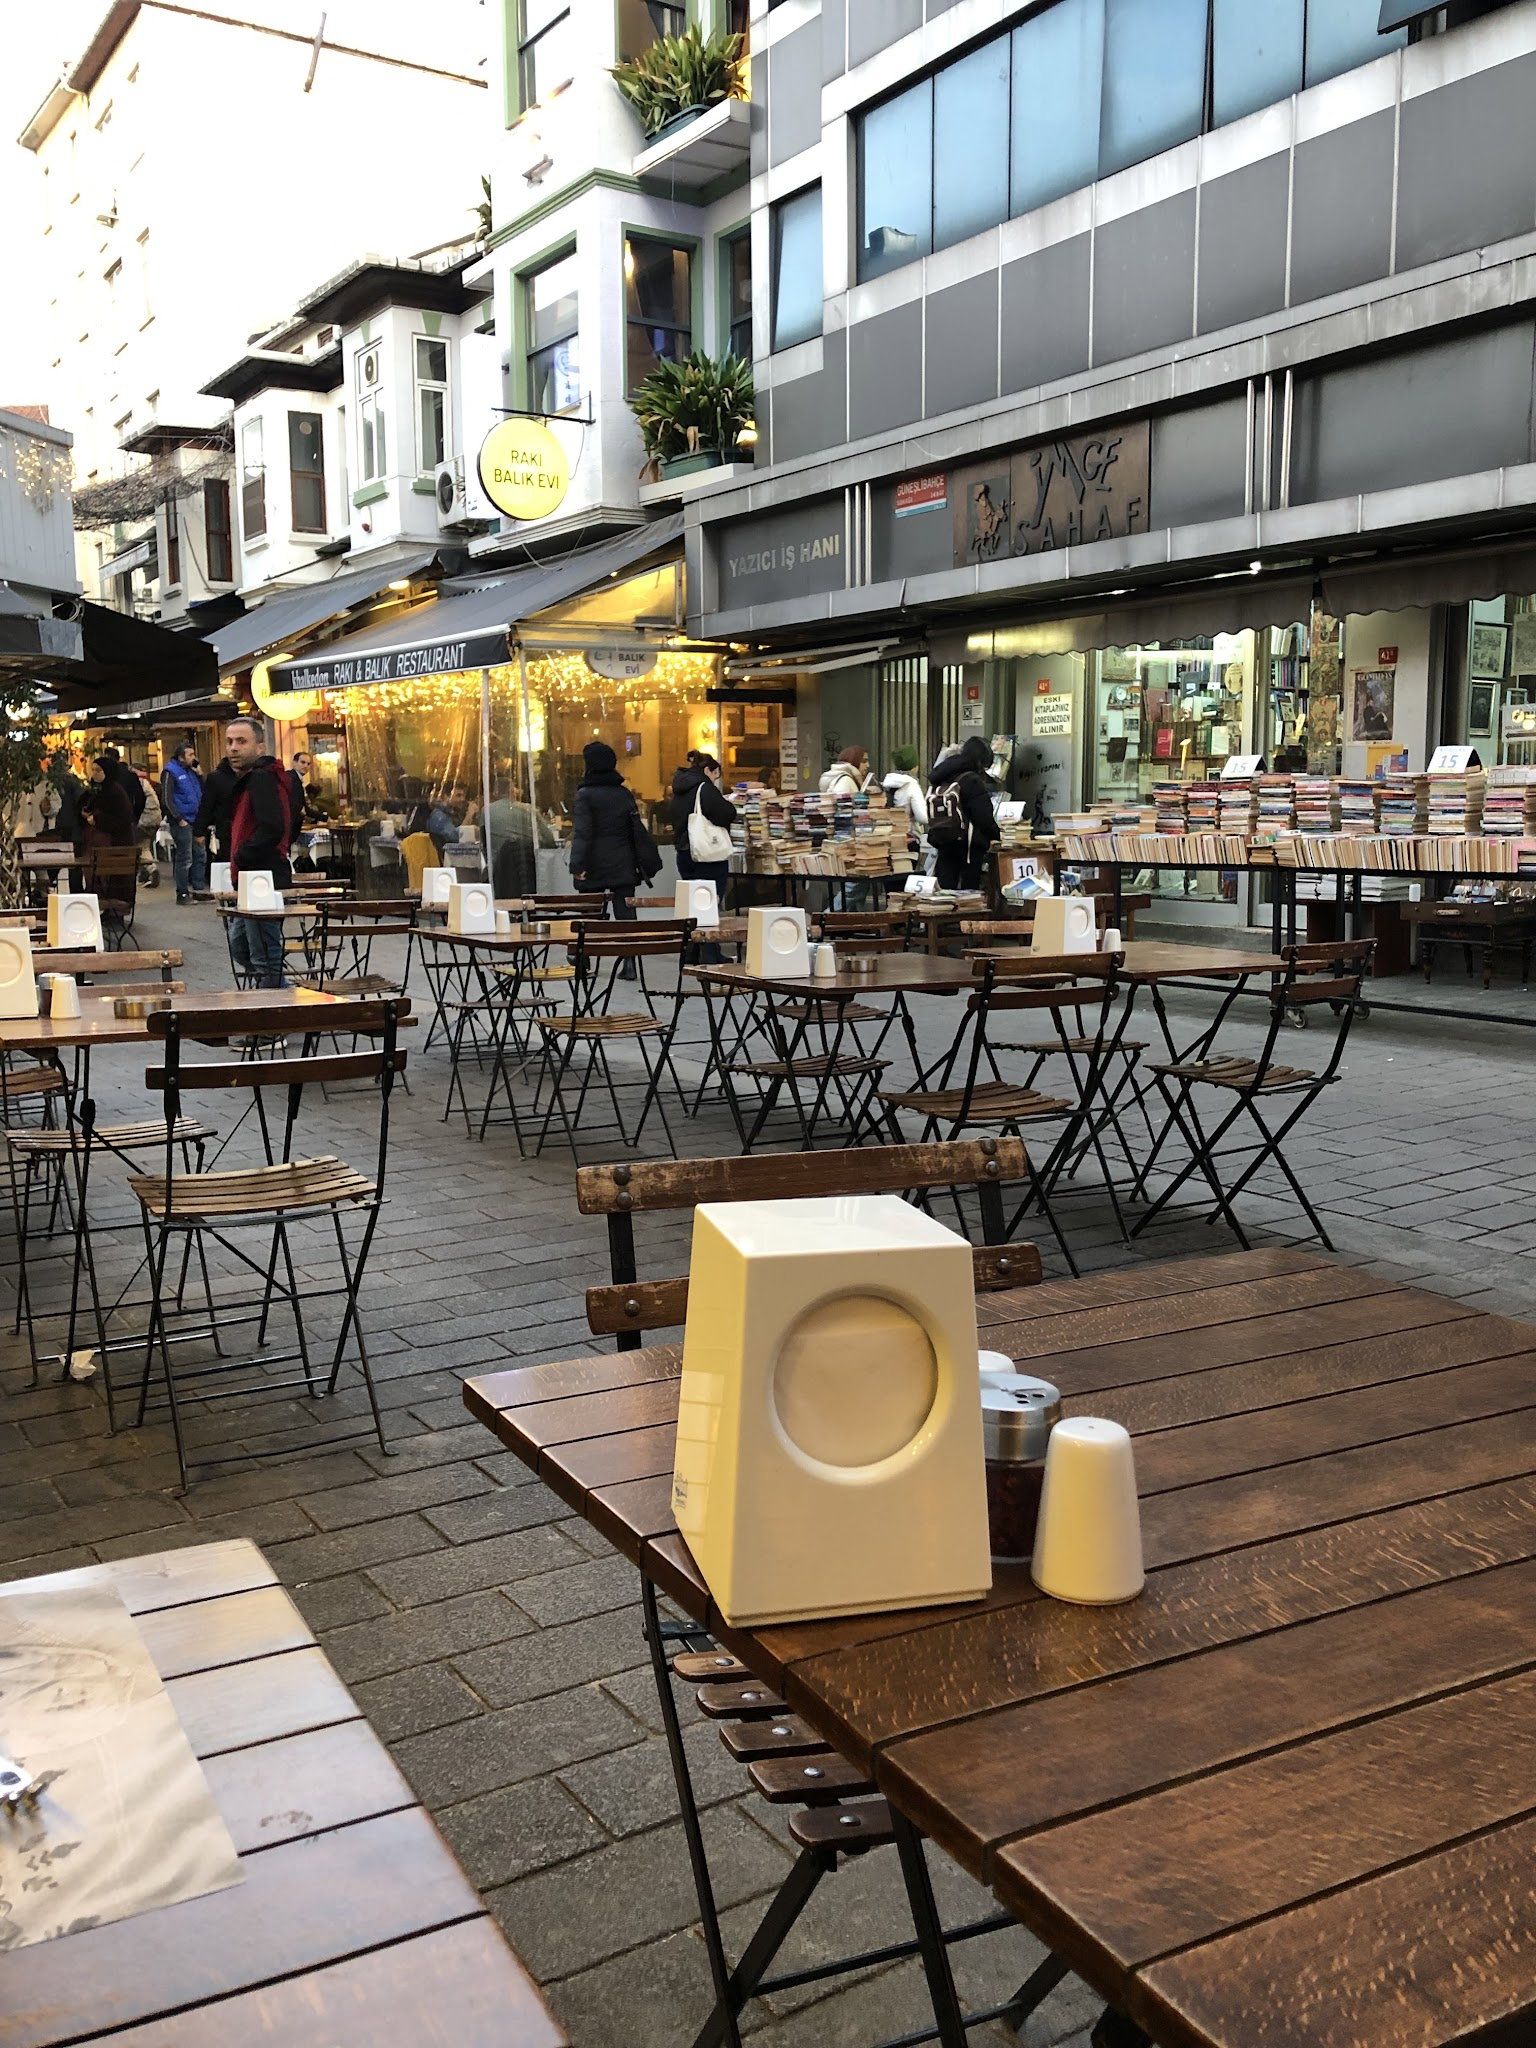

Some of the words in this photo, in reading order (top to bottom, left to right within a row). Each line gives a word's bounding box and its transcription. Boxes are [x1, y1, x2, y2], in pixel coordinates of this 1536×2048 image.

[511, 449, 542, 467] RAKI
[494, 468, 534, 487] BALIK
[538, 473, 559, 489] EVI
[1012, 496, 1141, 557] SAHAF
[729, 549, 776, 578] YAZICI
[781, 543, 795, 571] İŞ
[800, 534, 840, 564] HANI
[333, 661, 354, 685] RAKI
[356, 660, 363, 682] &
[364, 656, 392, 681] BALIK
[396, 643, 466, 676] RESTAURANT
[618, 653, 646, 662] BALIK
[1039, 725, 1064, 734] ALINIR
[1232, 762, 1249, 773] 15
[1438, 755, 1459, 768] 15
[1018, 864, 1034, 879] 10
[914, 880, 924, 893] 5
